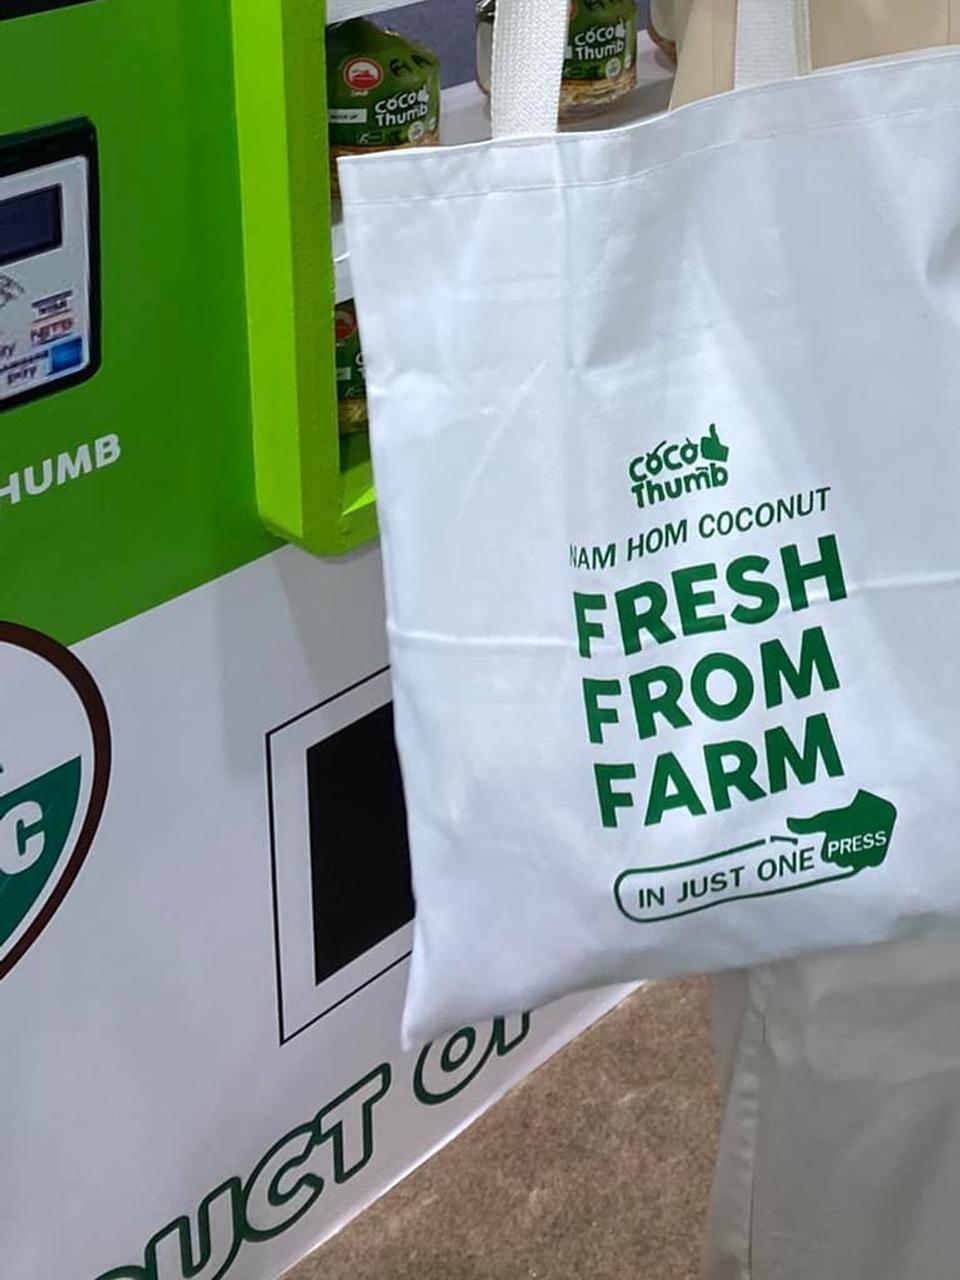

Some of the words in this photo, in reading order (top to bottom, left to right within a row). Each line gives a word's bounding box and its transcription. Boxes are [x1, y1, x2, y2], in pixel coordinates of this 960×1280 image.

[575, 38, 625, 61] Thumb
[375, 105, 429, 127] Thumb
[627, 519, 688, 562] HOM
[698, 486, 831, 539] COCONUT
[631, 462, 729, 509] Thumb
[573, 534, 848, 659] FRESH
[582, 626, 840, 745] FROM
[593, 713, 845, 828] FARM
[638, 886, 665, 909] IN
[676, 865, 746, 903] JUST
[757, 846, 816, 882] ONE
[827, 830, 888, 859] PRESS
